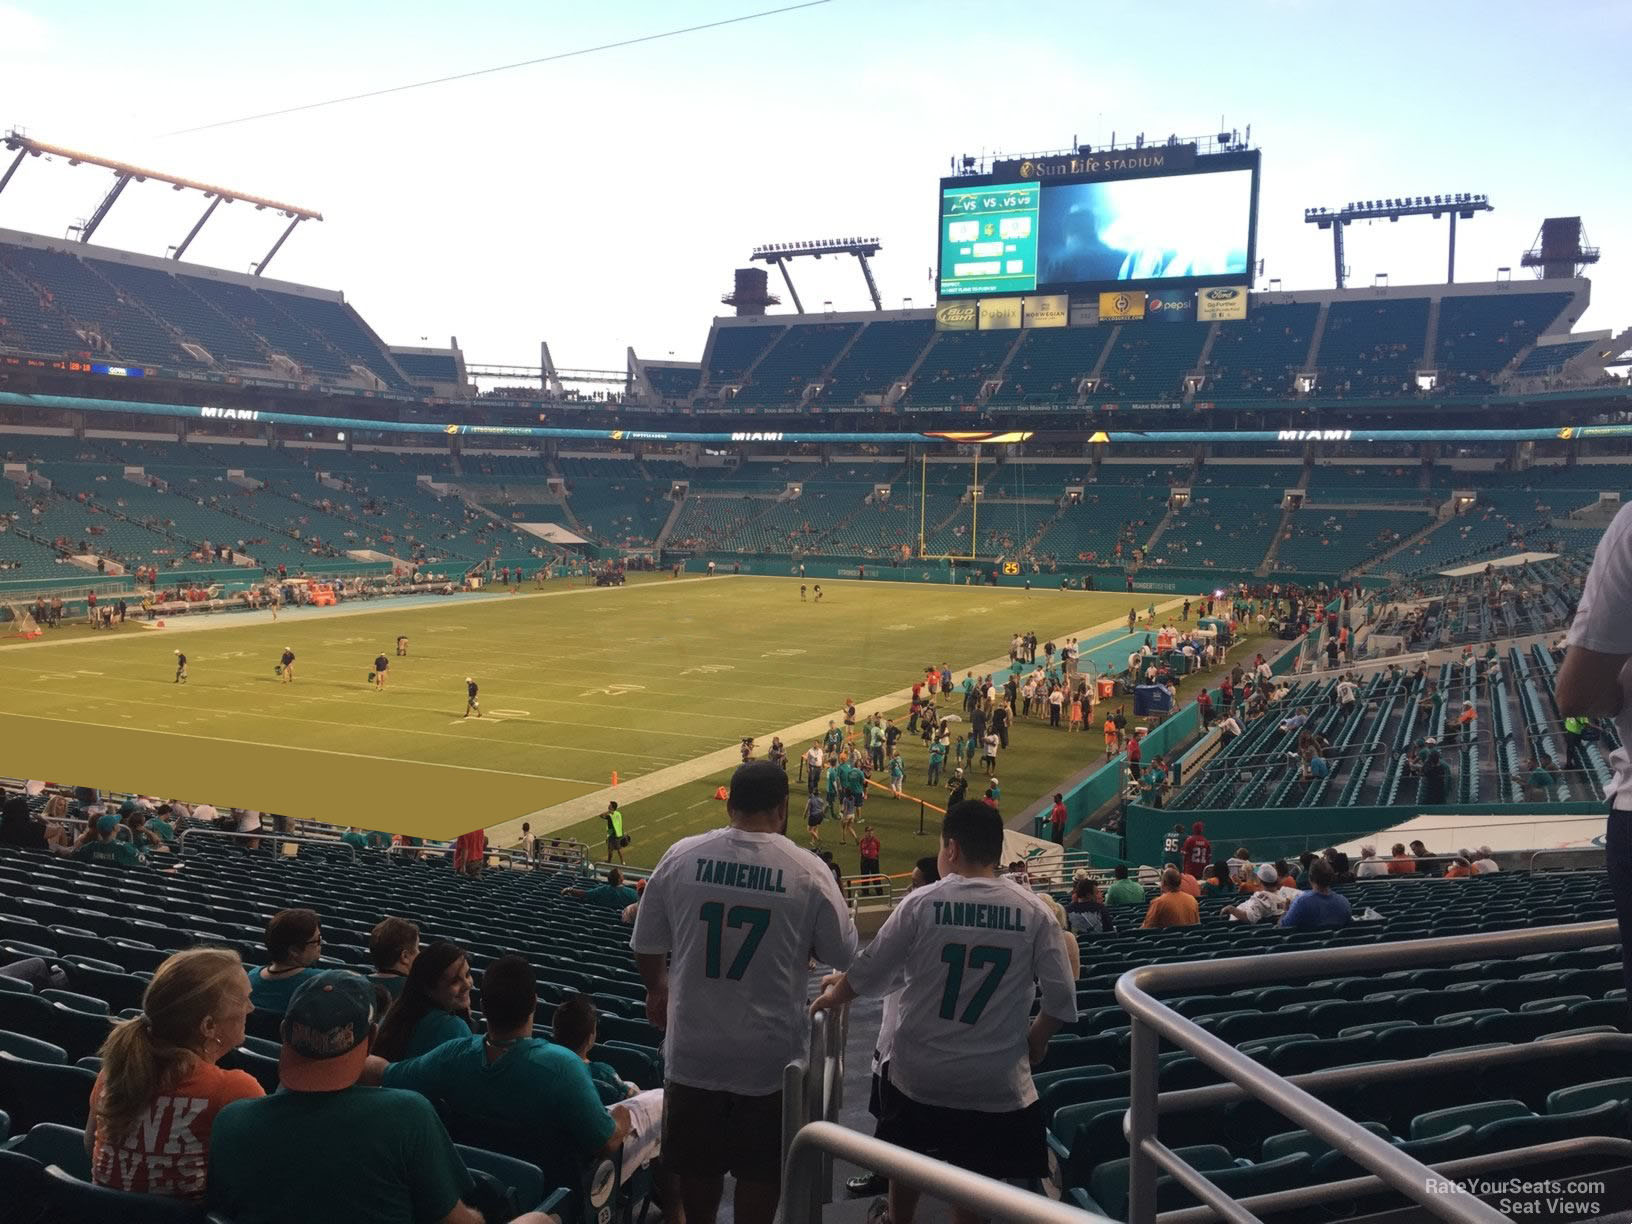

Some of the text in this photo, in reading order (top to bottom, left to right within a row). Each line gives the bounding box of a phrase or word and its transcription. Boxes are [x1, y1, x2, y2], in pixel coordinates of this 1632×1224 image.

[1036, 156, 1165, 177] Sun Life STADIUM
[1164, 300, 1191, 310] pepsi
[981, 309, 1017, 319] Publix
[201, 406, 258, 420] MIAMI
[731, 432, 783, 440] MIAMI
[1278, 430, 1351, 440] MIAMI
[1005, 564, 1017, 574] 25
[1165, 838, 1179, 852] 95
[1191, 847, 1207, 863] 21
[697, 859, 786, 893] TANNEHILL
[933, 901, 1026, 931] TANNEHILL
[700, 902, 771, 981] 17
[939, 943, 1012, 1025] 17
[126, 1096, 208, 1154] NK
